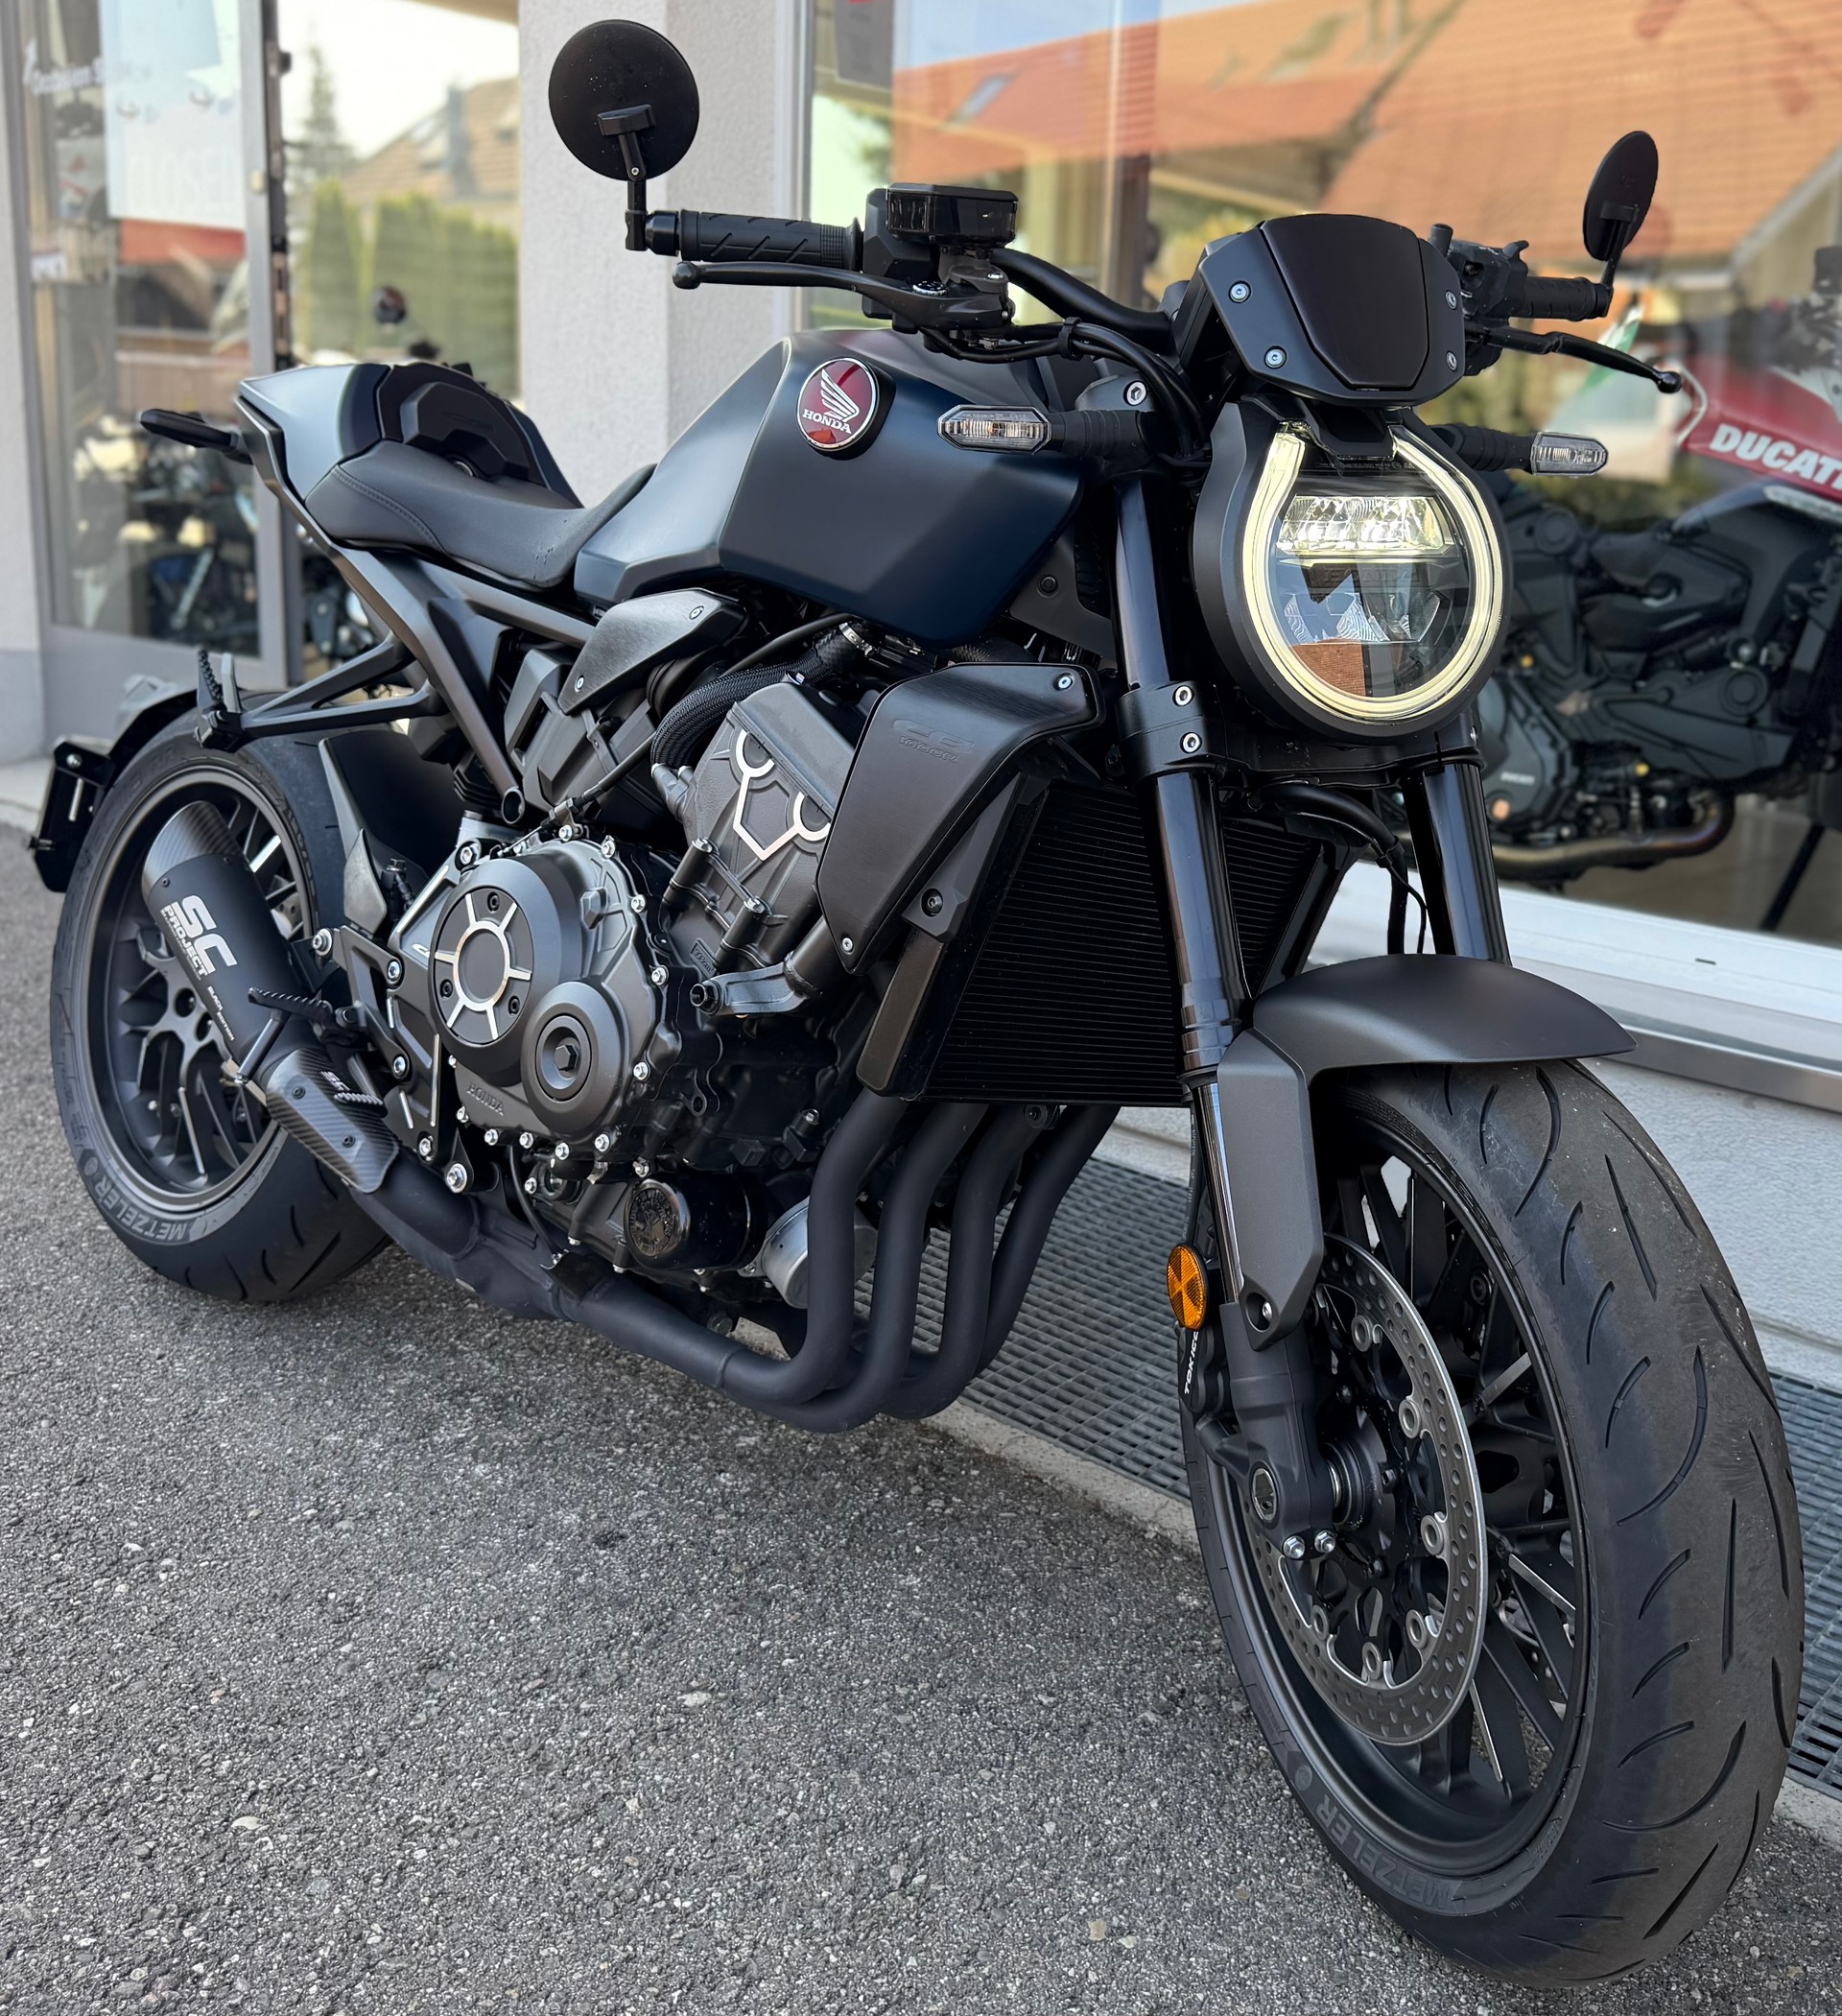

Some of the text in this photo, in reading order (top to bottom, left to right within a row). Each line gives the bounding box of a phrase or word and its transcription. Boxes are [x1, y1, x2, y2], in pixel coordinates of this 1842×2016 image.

[802, 409, 852, 434] HONDA
[899, 736, 958, 764] 1000R
[165, 904, 208, 977] PROJECT
[171, 894, 238, 974] SC
[467, 1082, 504, 1116] HONDA
[94, 1175, 188, 1241] METZELER
[1316, 1794, 1450, 1910] METZELER
